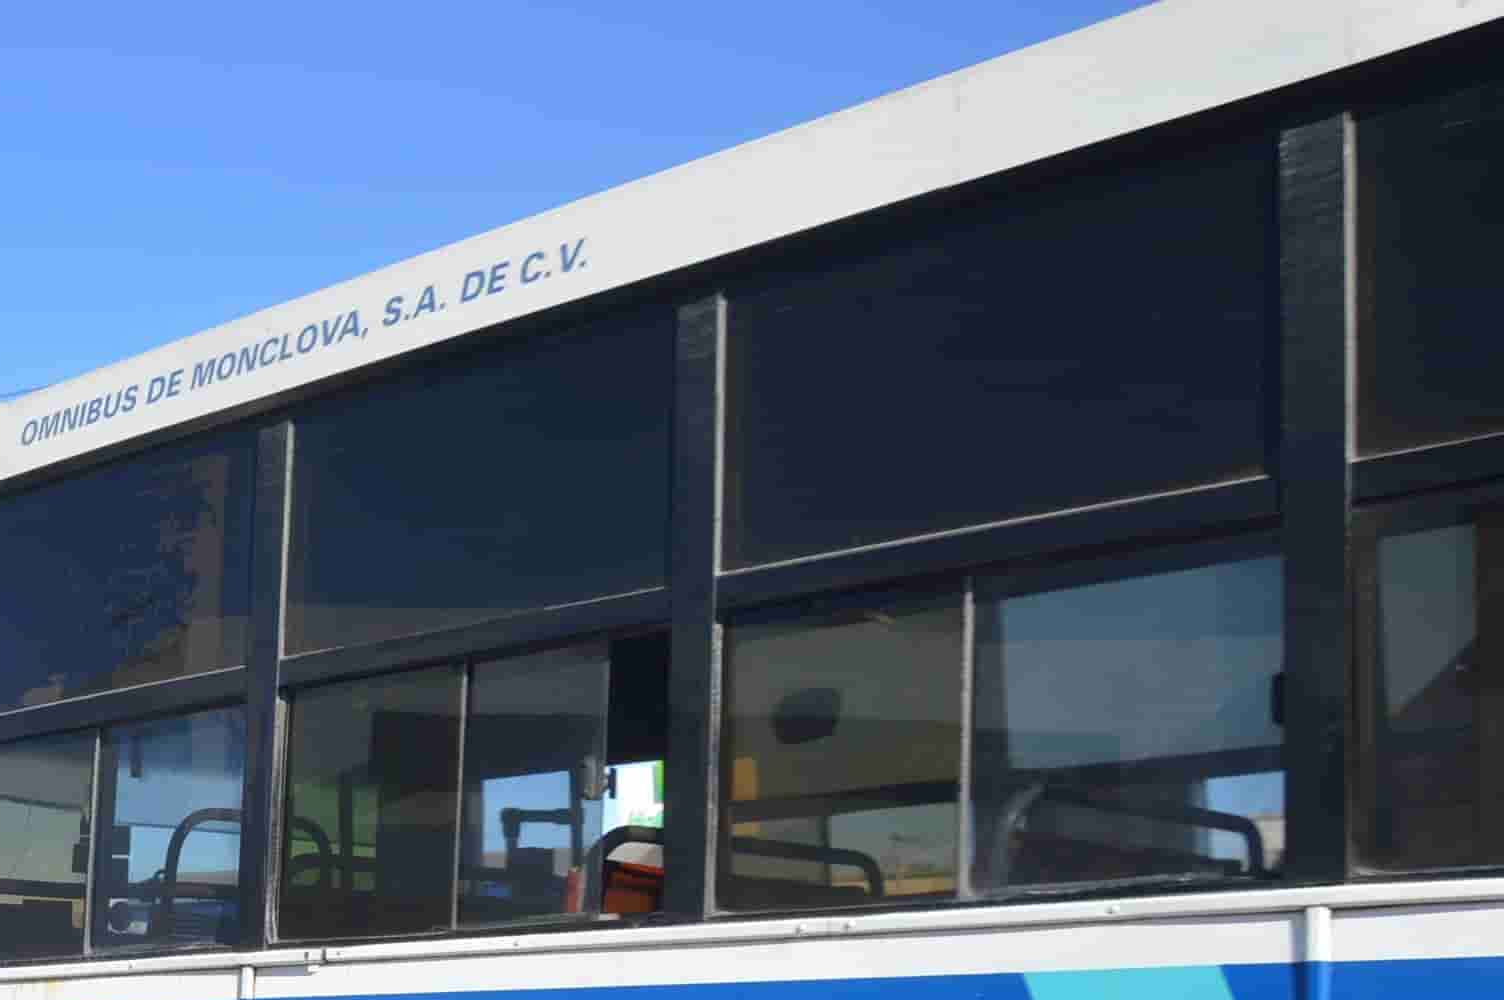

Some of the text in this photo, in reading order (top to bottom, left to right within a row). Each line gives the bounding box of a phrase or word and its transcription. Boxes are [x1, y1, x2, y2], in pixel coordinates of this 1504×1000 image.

[20, 236, 588, 446] OMNIBUS DE MONCLOVA, S.A. DE C.V.
